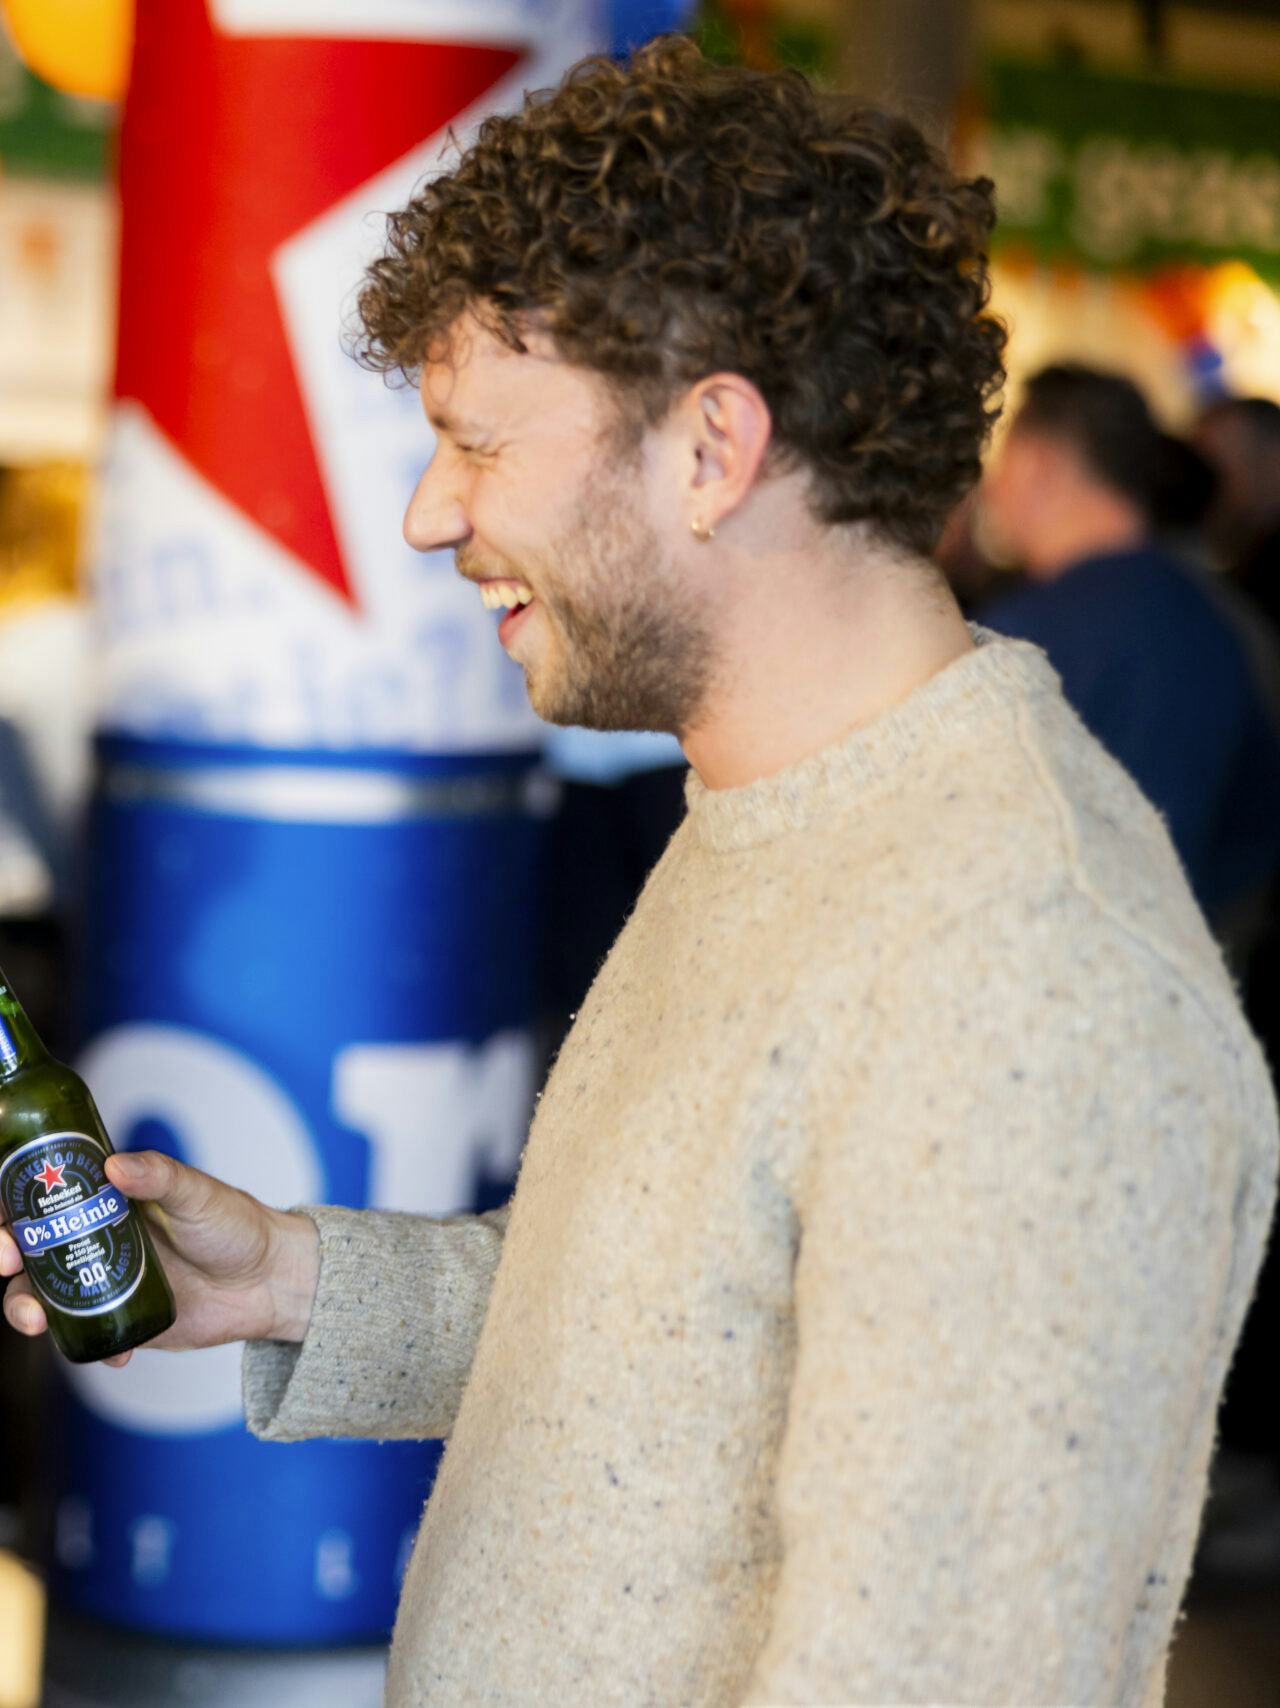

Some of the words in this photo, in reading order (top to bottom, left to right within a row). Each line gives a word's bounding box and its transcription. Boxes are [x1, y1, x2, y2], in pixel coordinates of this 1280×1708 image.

[54, 1151, 74, 1166] 0.0
[37, 1182, 82, 1209] Heineken
[24, 1225, 51, 1247] 0%
[49, 1197, 119, 1239] Heinie
[68, 1238, 92, 1252] Proost
[46, 1272, 74, 1297] PURE
[111, 1242, 131, 1282] LAGER
[79, 1261, 106, 1287] 0.0
